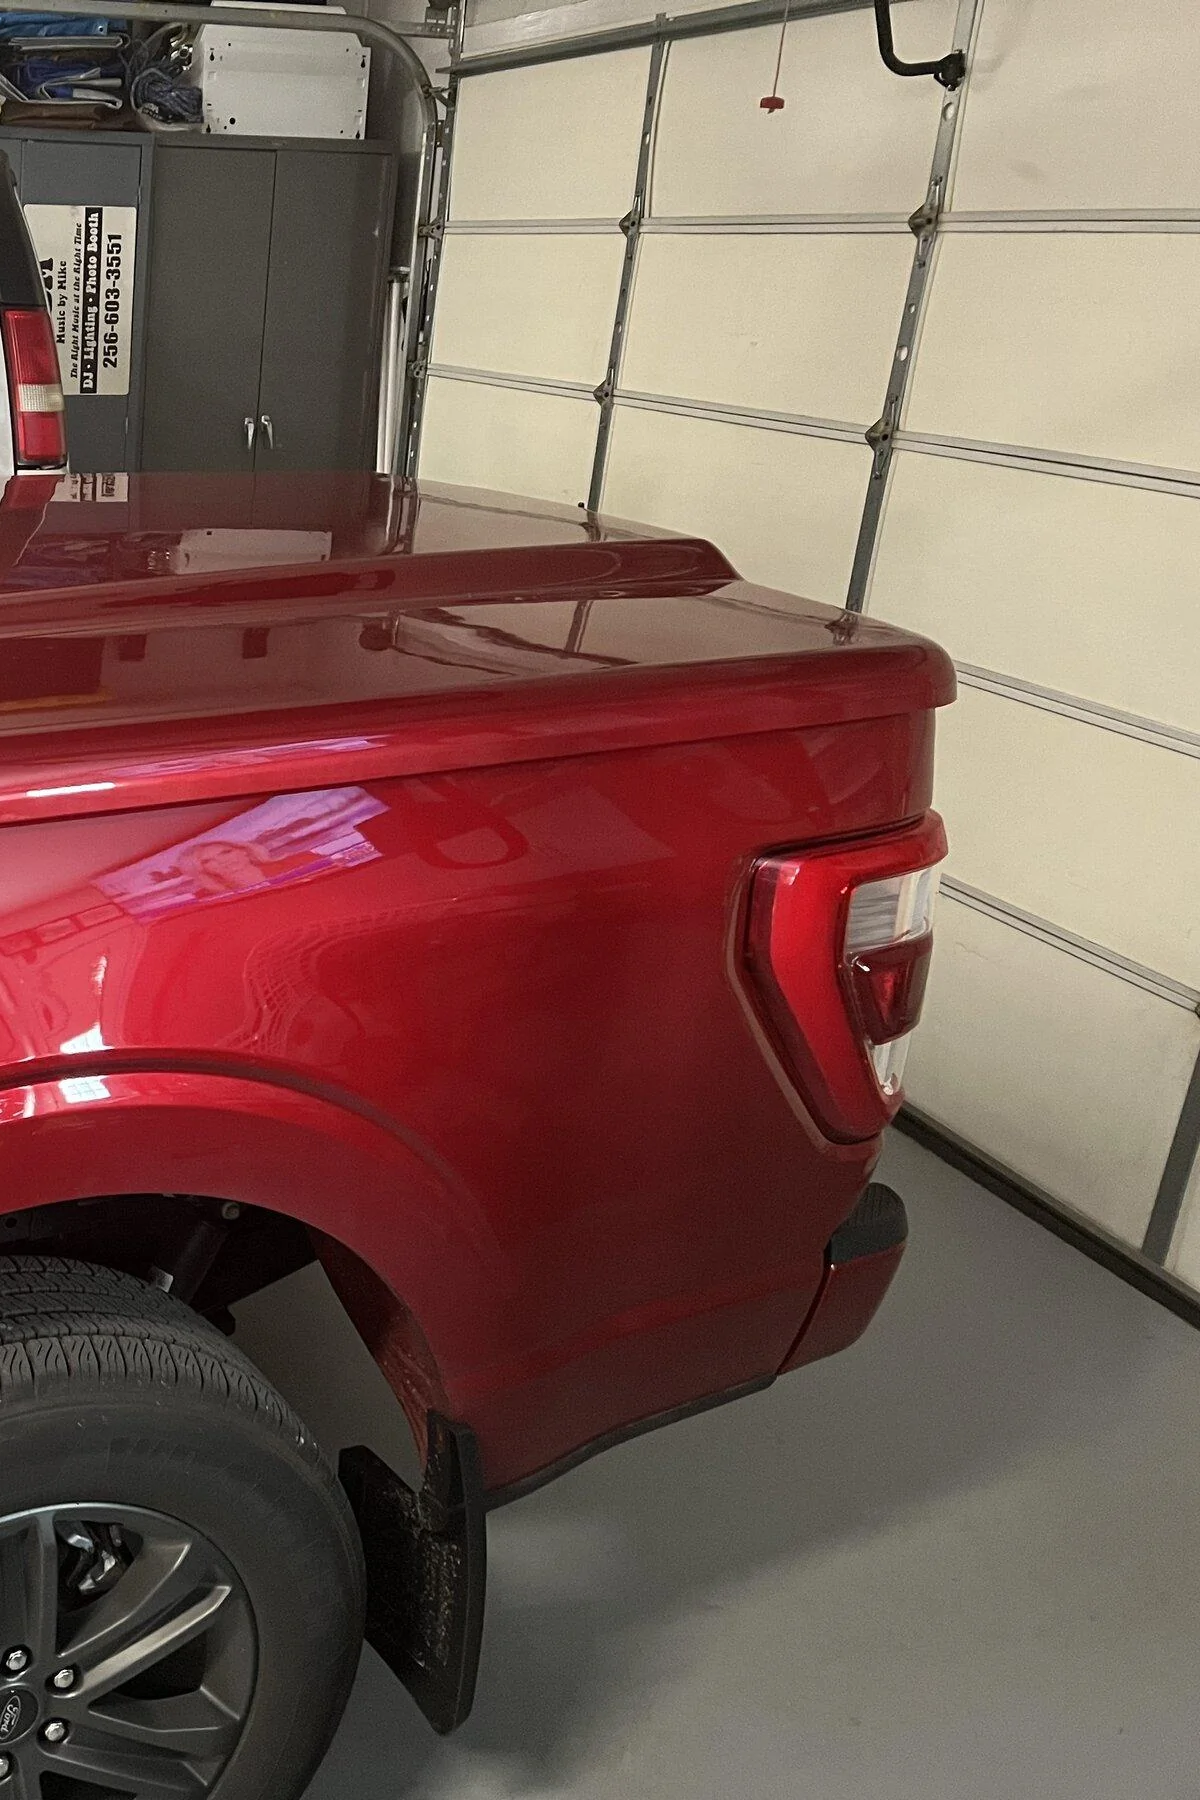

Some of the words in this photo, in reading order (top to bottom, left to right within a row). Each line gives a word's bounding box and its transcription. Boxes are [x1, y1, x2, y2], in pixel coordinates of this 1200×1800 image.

[87, 212, 99, 253] Booth
[57, 260, 67, 290] Mike
[85, 255, 98, 294] Photo
[57, 293, 68, 307] by
[102, 234, 122, 369] 256-603-3551
[56, 310, 66, 344] Music
[72, 305, 80, 333] Music
[83, 305, 98, 360] Lighting
[82, 373, 94, 389] DJ
[0, 1704, 19, 1733] Ford
